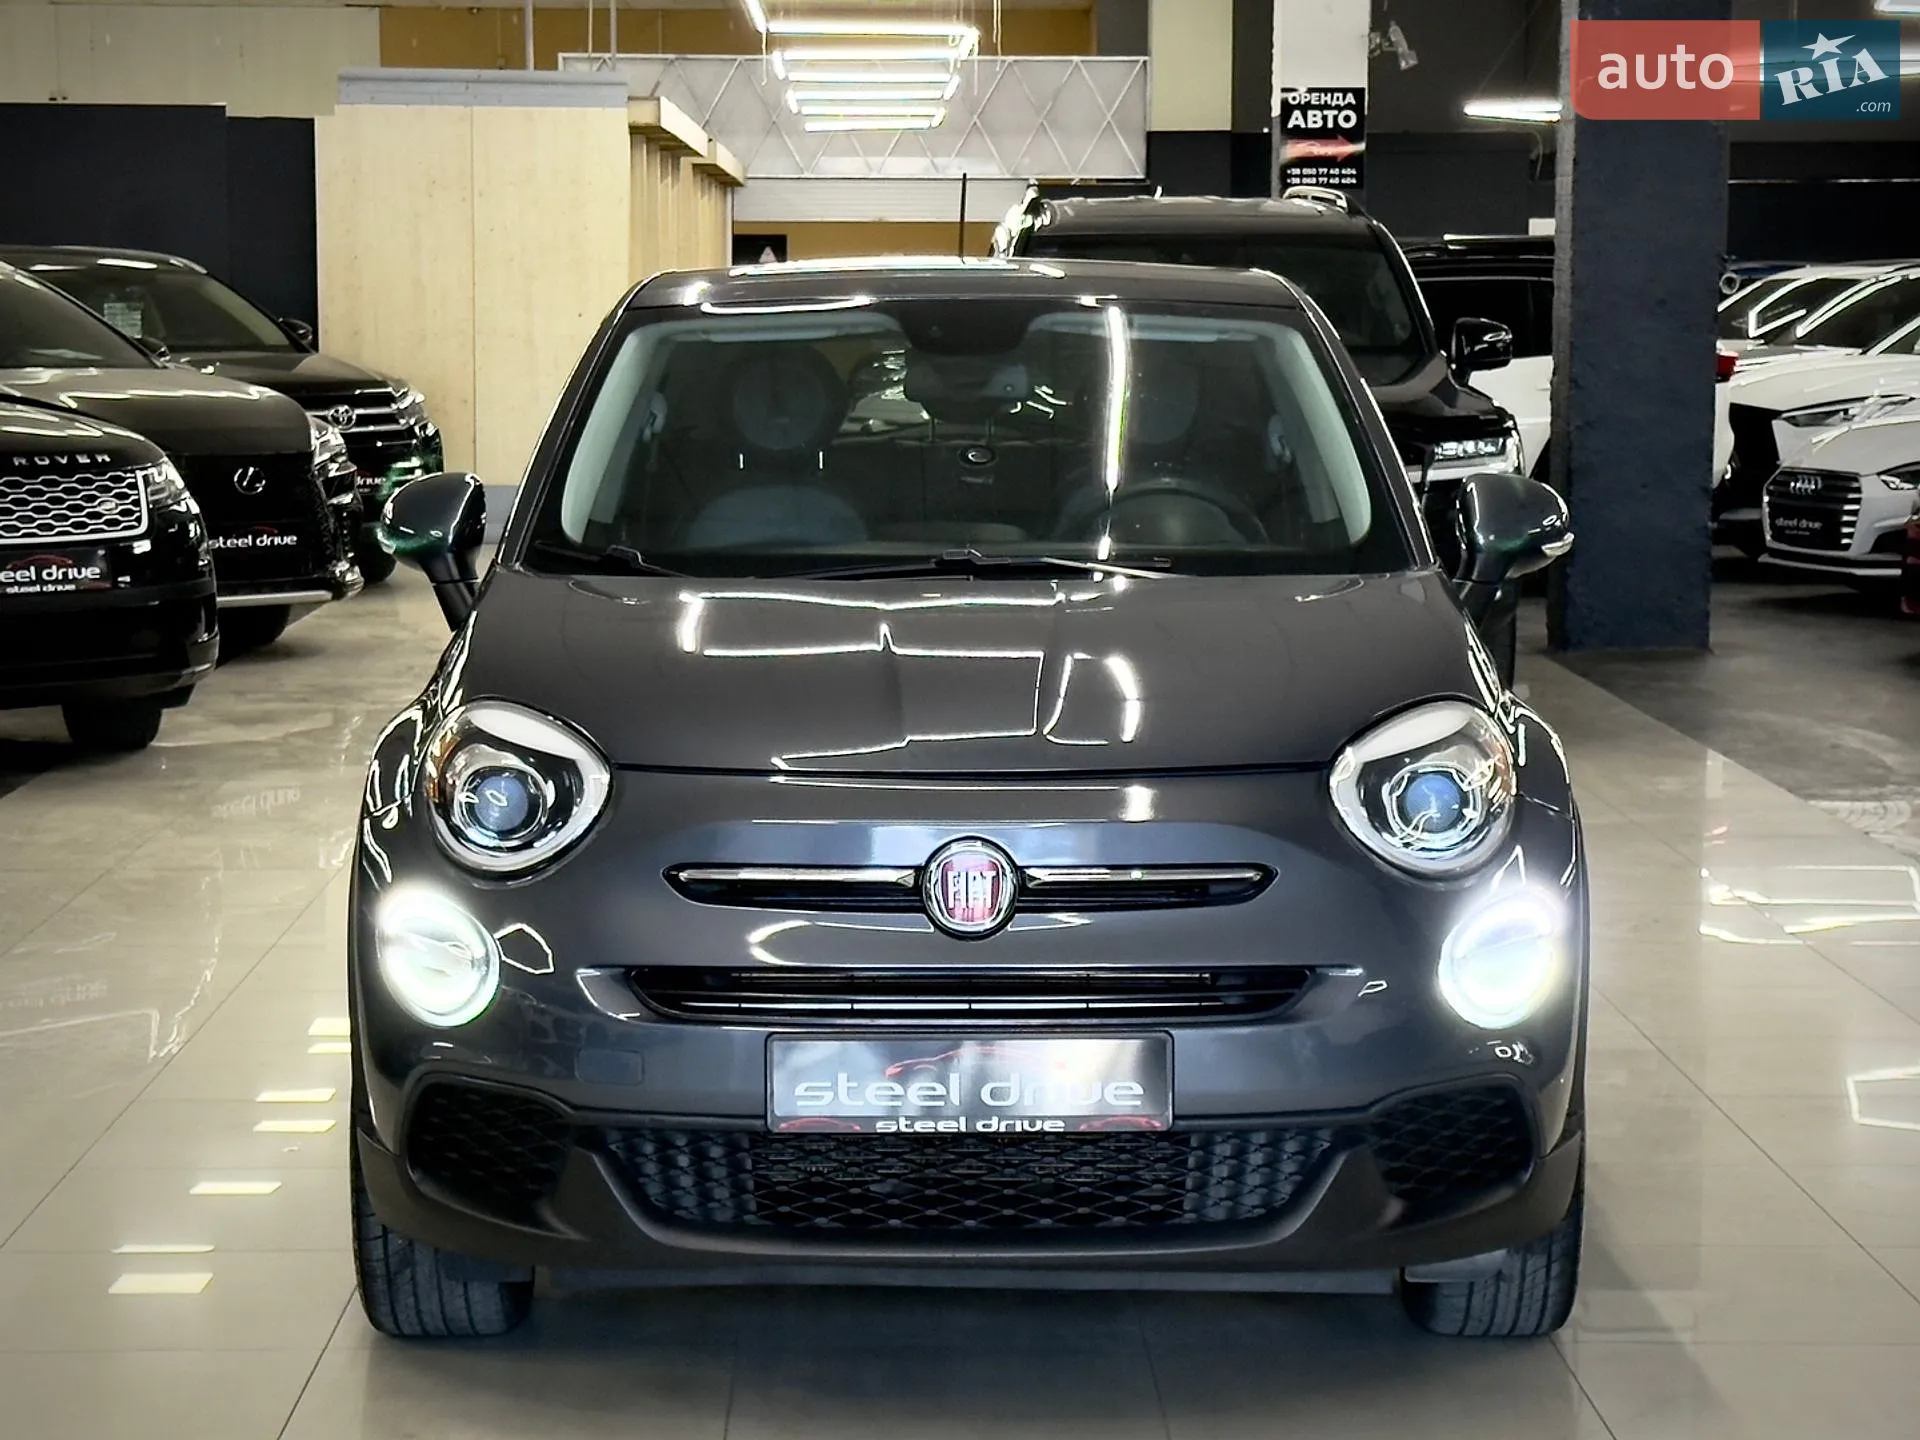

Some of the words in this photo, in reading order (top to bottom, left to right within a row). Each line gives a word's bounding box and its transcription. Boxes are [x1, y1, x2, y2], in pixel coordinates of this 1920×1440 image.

[1287, 92, 1356, 107] ОРЕНДА
[1287, 109, 1357, 129] АВТО
[12, 453, 111, 466] ROVER
[208, 534, 252, 548] steel
[256, 534, 298, 547] drive
[42, 564, 101, 581] drive
[6, 584, 41, 594] steel
[42, 582, 77, 593] drive
[946, 869, 997, 909] FIAT
[794, 1072, 960, 1107] steel
[980, 1072, 1144, 1107] drive
[876, 1116, 967, 1132] steel
[975, 1116, 1066, 1132] drive
